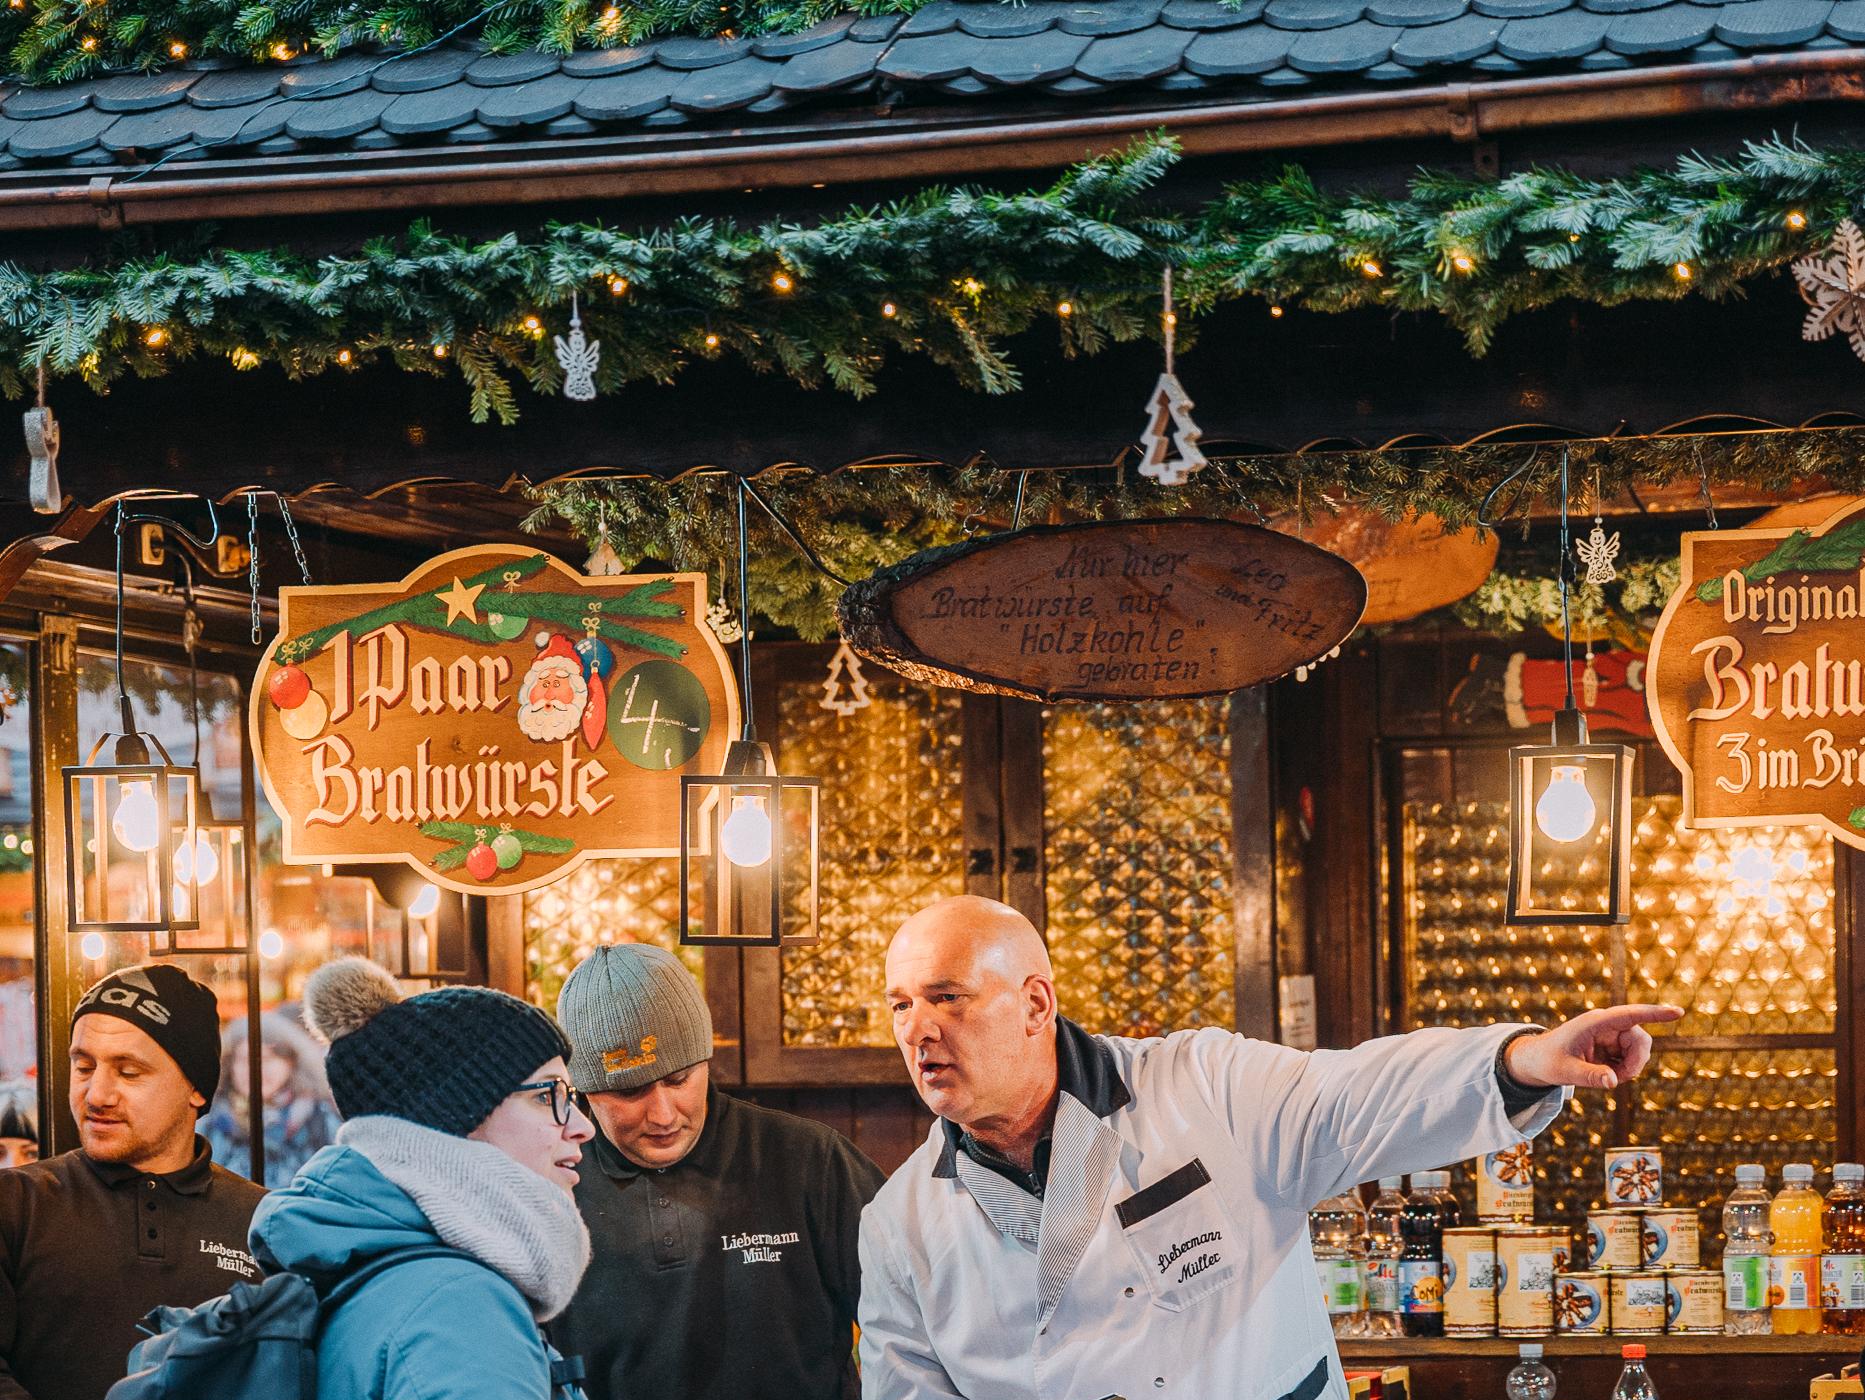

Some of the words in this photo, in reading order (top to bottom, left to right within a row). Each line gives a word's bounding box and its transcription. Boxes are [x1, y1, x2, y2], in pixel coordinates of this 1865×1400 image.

[1121, 544, 1188, 578] hier
[1118, 583, 1174, 617] auf
[352, 624, 512, 731] Paar
[302, 734, 615, 829] Bratwürste
[200, 1240, 260, 1268] Lieberma
[721, 1232, 800, 1251] Liebermann
[741, 1247, 782, 1264] Müller
[1158, 1231, 1222, 1274] Liebermann
[217, 1256, 255, 1278] Müller
[1178, 1252, 1221, 1283] Müller
